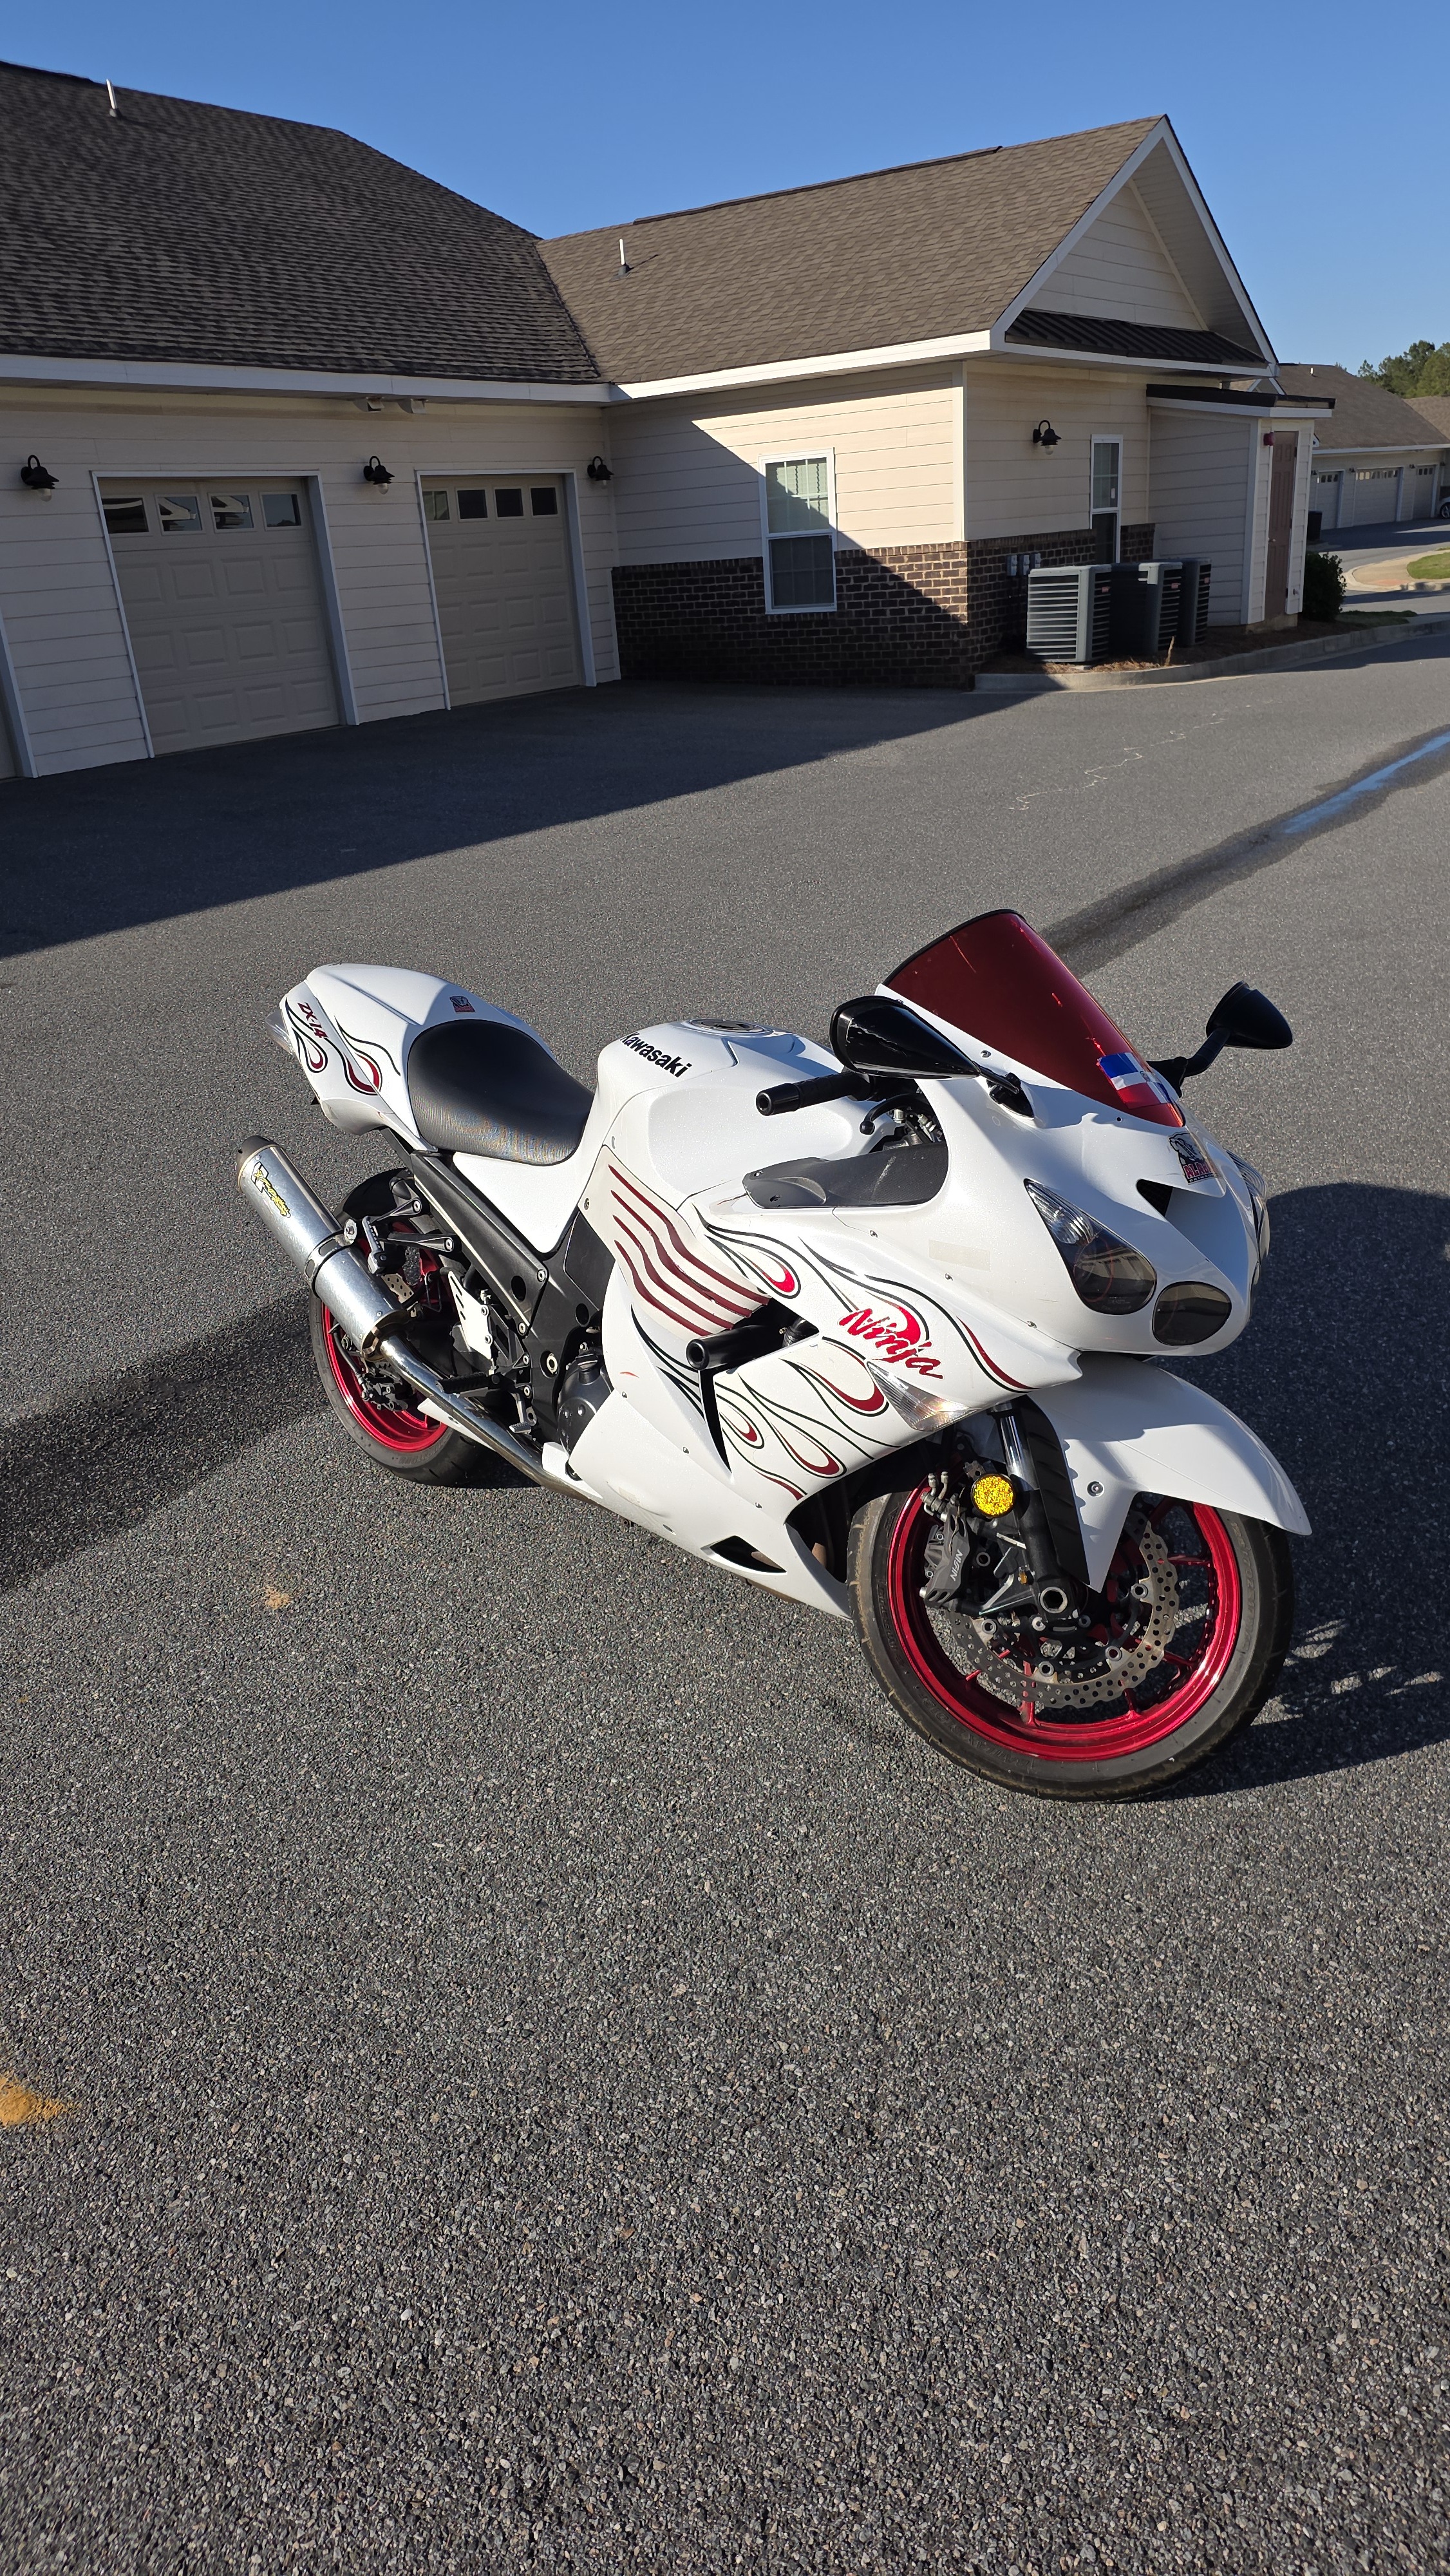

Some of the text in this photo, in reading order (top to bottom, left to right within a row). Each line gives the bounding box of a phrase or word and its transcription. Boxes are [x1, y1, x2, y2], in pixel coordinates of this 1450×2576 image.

[297, 1002, 329, 1038] ZX-14
[620, 1032, 693, 1077] Kawasaki
[839, 1309, 943, 1379] Ninja
[950, 1549, 963, 1582] NISSIN
